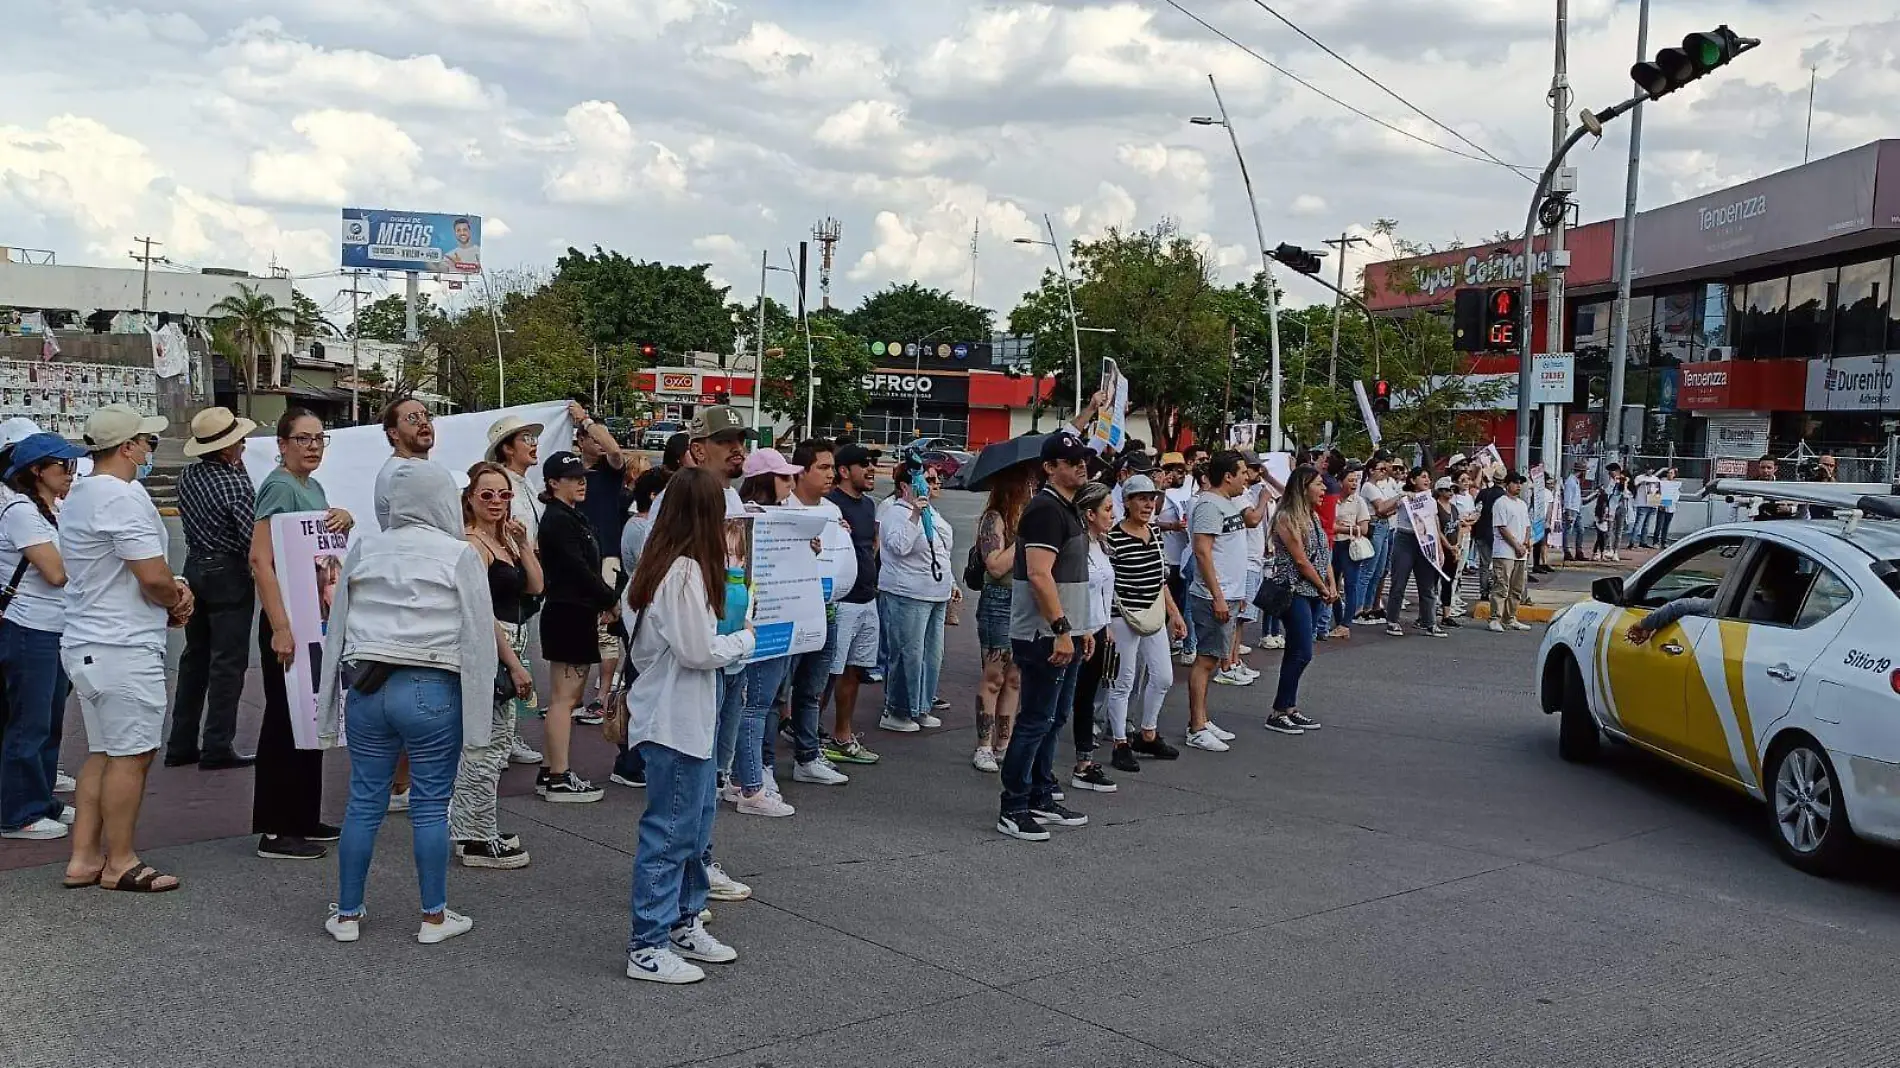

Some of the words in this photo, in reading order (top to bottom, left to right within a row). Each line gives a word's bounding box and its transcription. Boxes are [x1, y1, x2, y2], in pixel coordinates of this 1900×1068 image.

[376, 222, 434, 247] MEGAS
[664, 377, 693, 388] OXXO
[726, 409, 740, 425] LA
[300, 520, 314, 535] TE
[318, 535, 330, 550] EN
